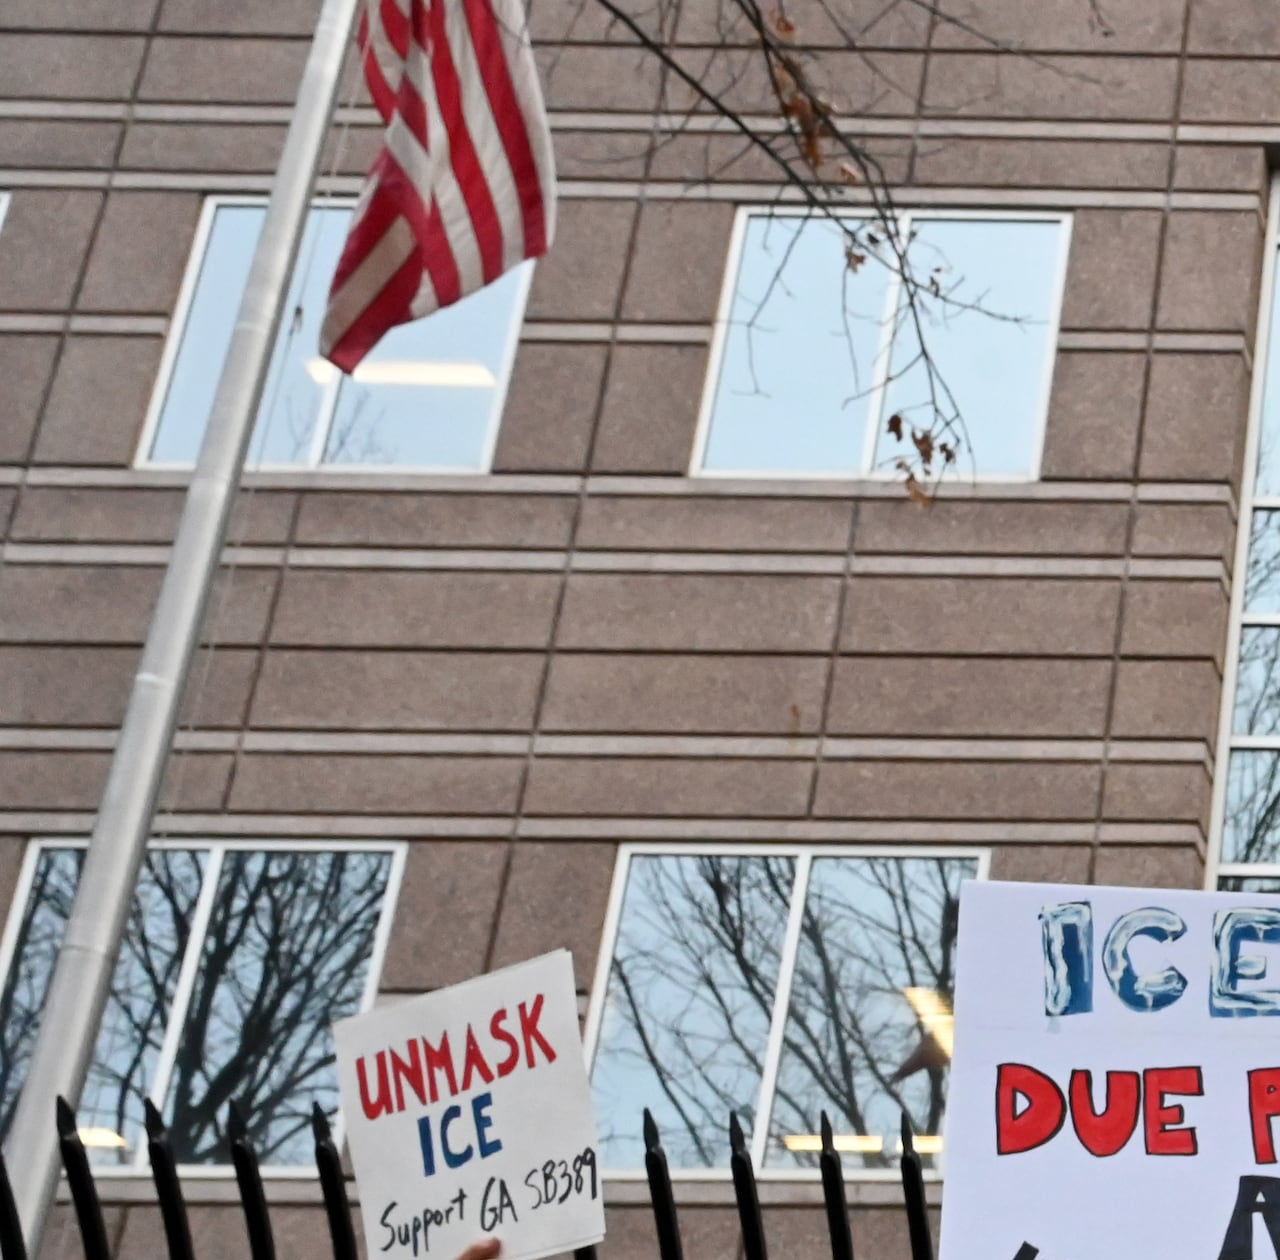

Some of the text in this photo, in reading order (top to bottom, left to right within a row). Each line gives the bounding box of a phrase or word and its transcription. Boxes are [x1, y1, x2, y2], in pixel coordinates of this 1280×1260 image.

[356, 993, 557, 1120] UNMASK
[417, 1091, 503, 1177] ICE
[995, 1062, 1204, 1157] DUE
[380, 1146, 598, 1257] Support GA SB389
